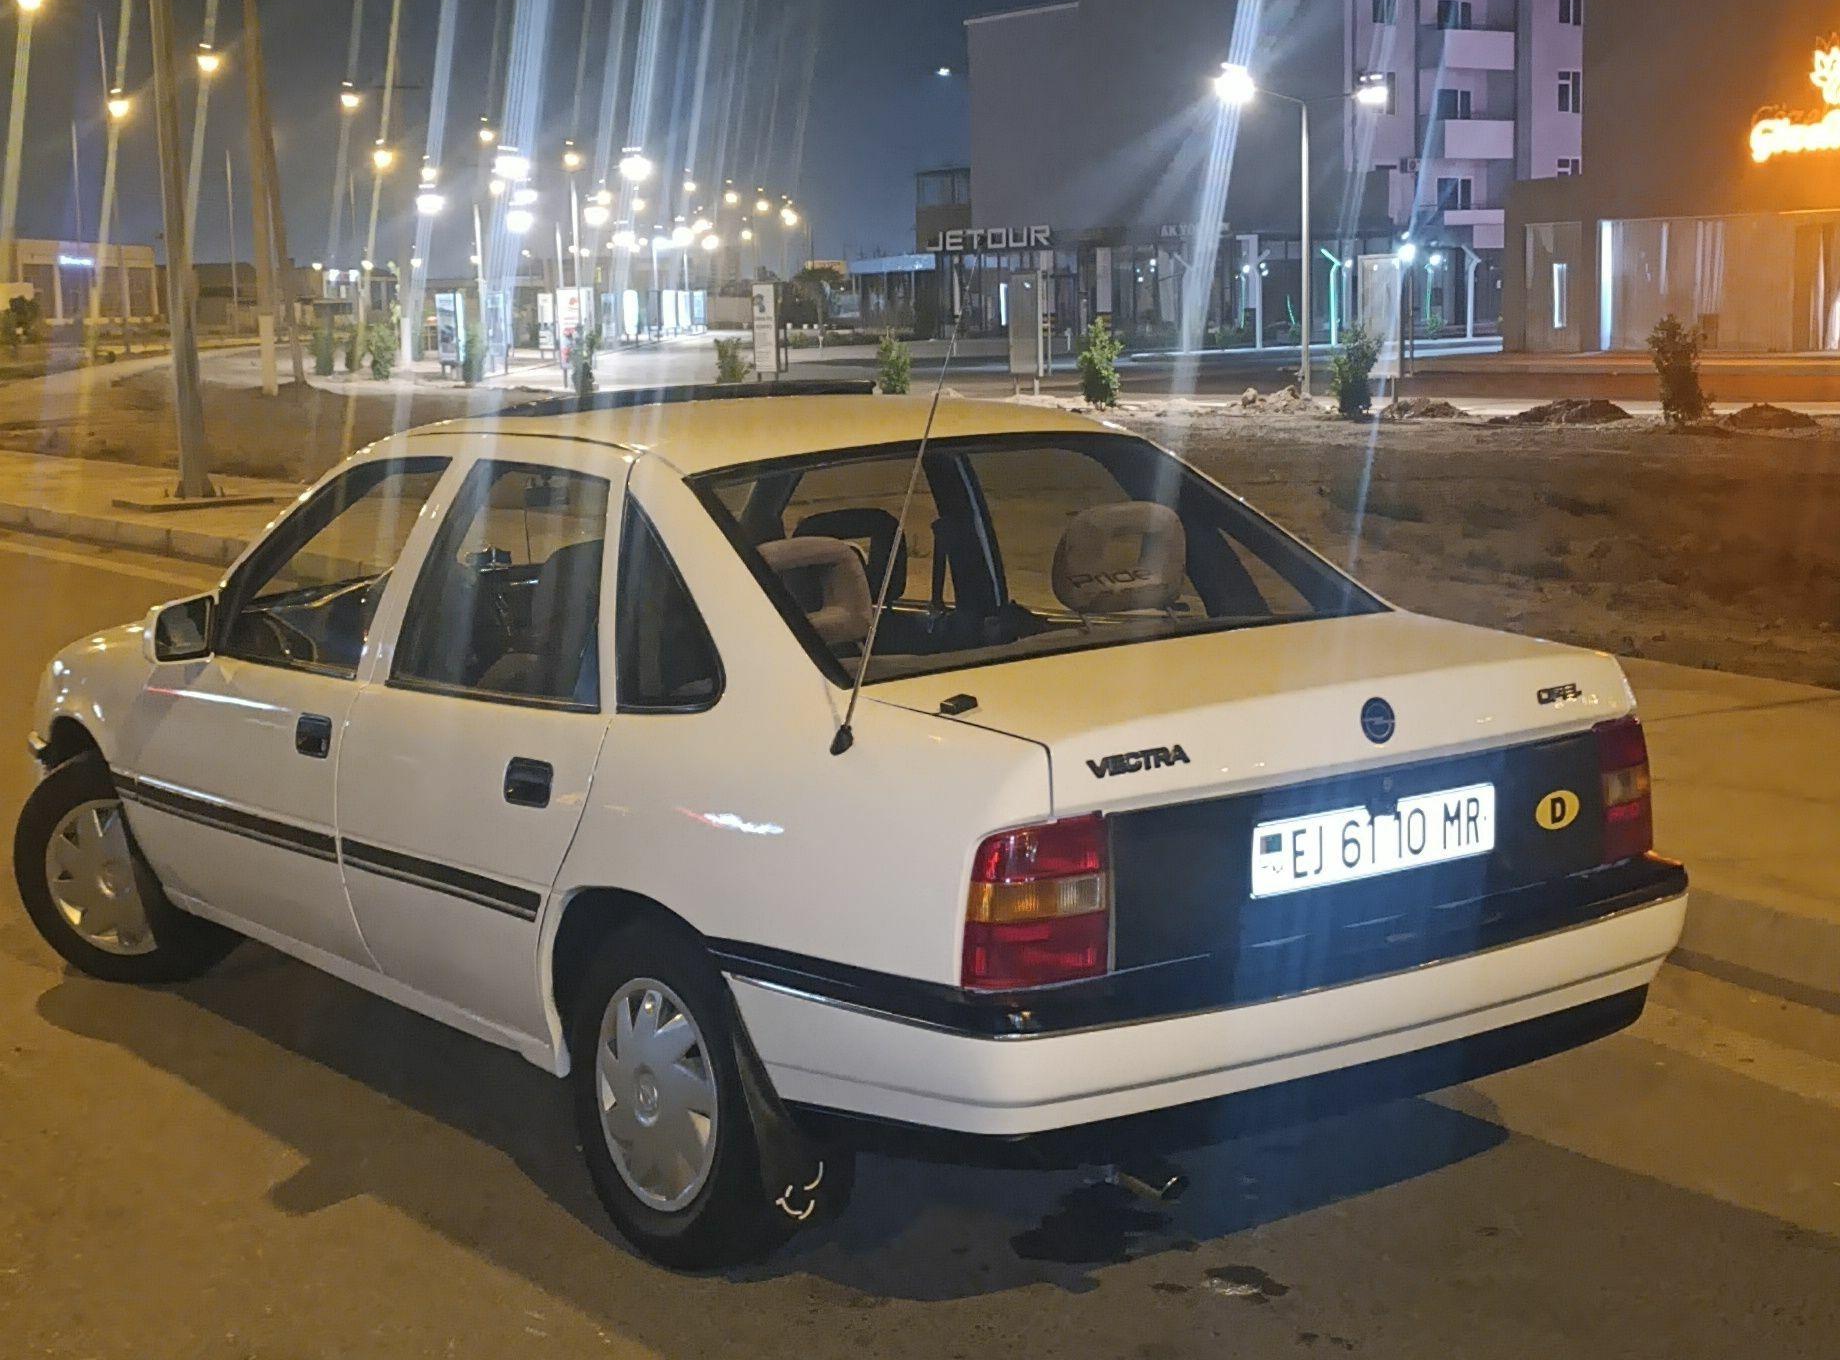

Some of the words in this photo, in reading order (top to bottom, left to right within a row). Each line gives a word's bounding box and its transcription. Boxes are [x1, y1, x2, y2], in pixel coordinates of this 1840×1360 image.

[926, 225, 1050, 251] JETOUR
[1086, 745, 1190, 778] VECTRA
[1550, 796, 1566, 824] D
[1292, 825, 1323, 879] EJ
[1443, 797, 1480, 850] MR
